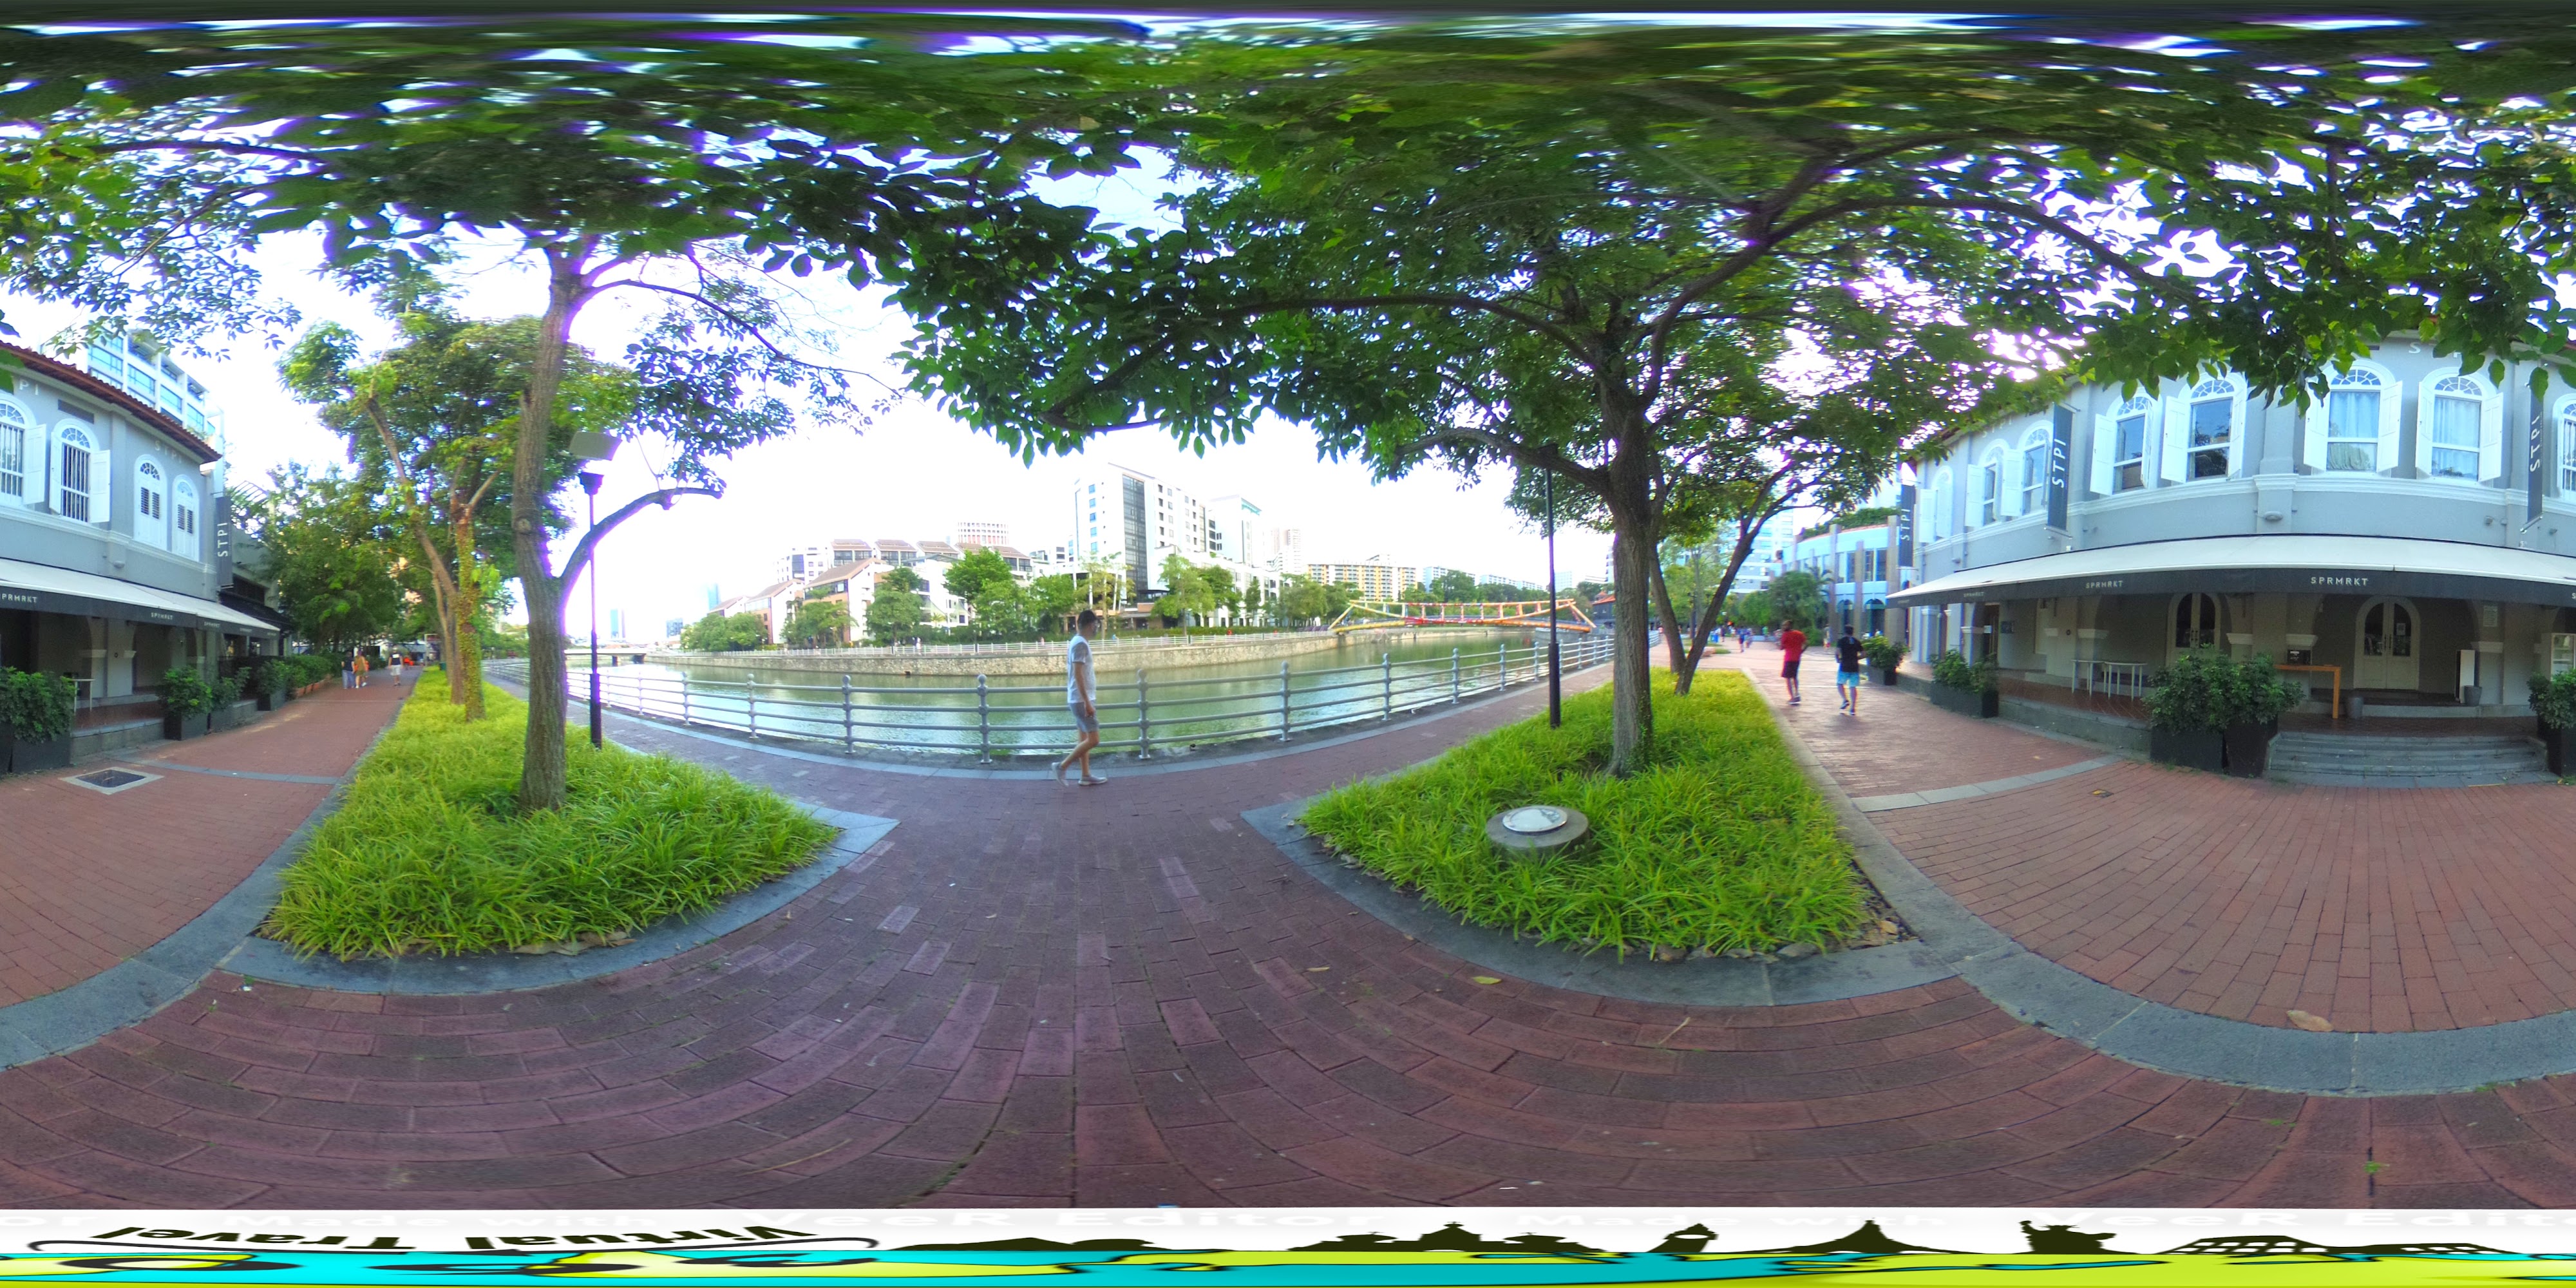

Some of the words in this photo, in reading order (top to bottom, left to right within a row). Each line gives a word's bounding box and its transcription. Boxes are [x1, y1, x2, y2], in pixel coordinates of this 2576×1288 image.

[2530, 415, 2541, 472] STPI
[2052, 439, 2067, 489] STPI
[217, 522, 229, 557] STPI
[1900, 509, 1911, 541] STPI
[2085, 580, 2123, 589] SPRMRKT
[2310, 576, 2369, 587] SPRMRKT
[1, 593, 37, 603] PRMRKT
